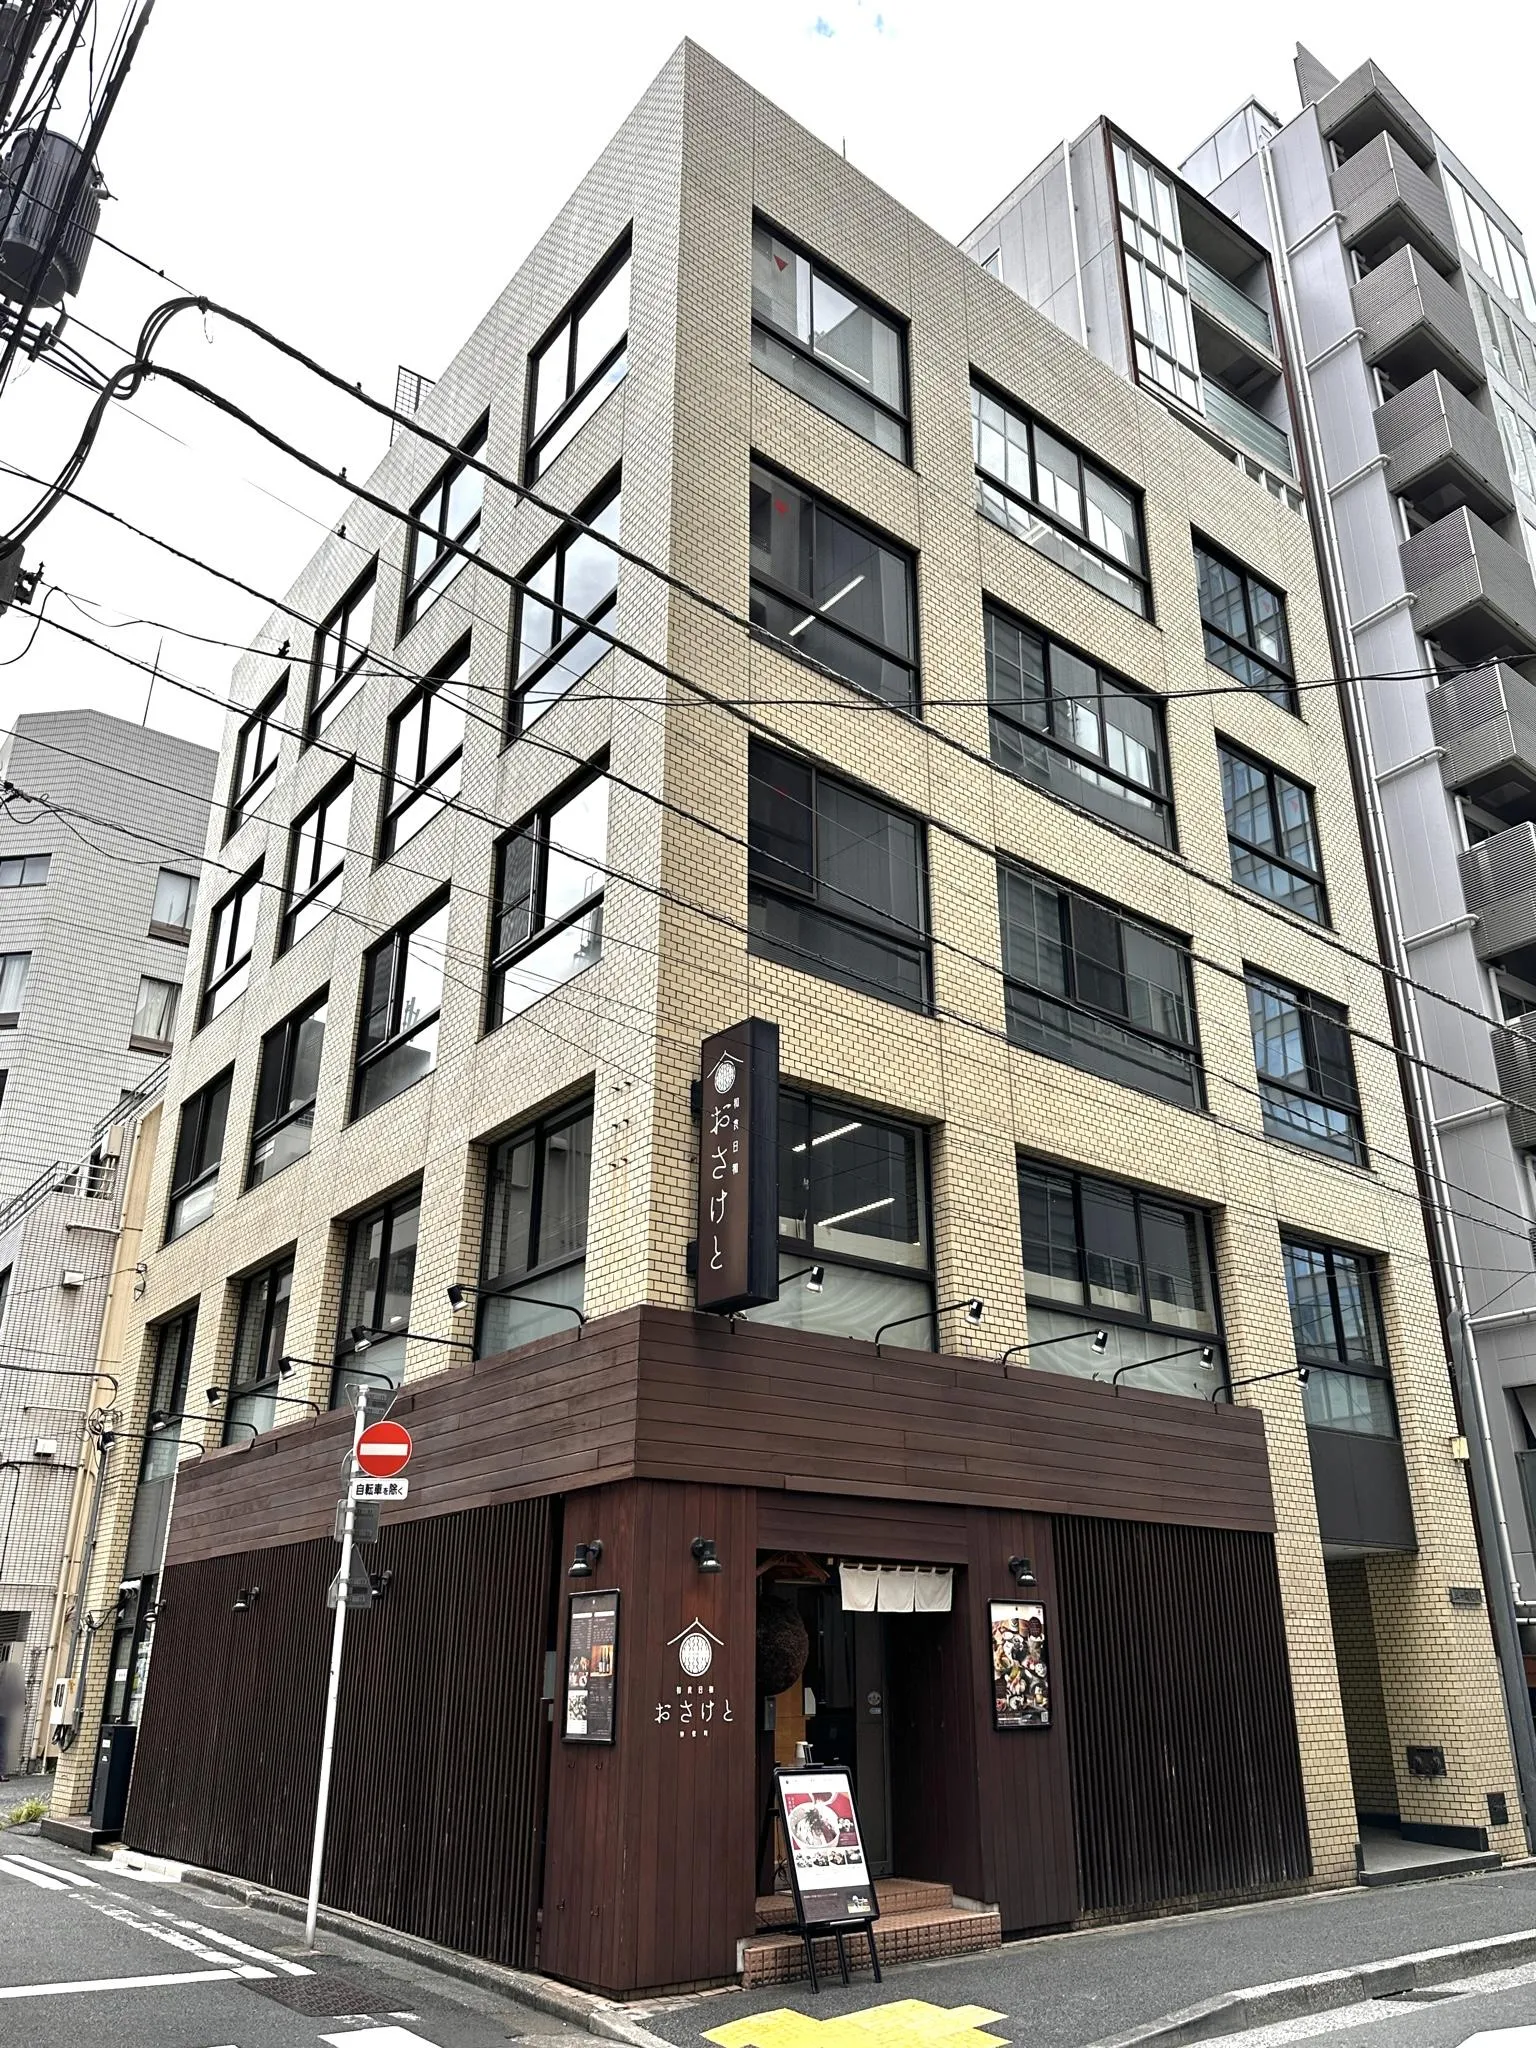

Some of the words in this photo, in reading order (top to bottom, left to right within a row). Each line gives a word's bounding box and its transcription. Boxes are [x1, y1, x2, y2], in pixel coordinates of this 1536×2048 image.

[709, 1103, 732, 1270] おさけと
[356, 1483, 403, 1496] 自転車を除く
[654, 1698, 734, 1724] おさけと
